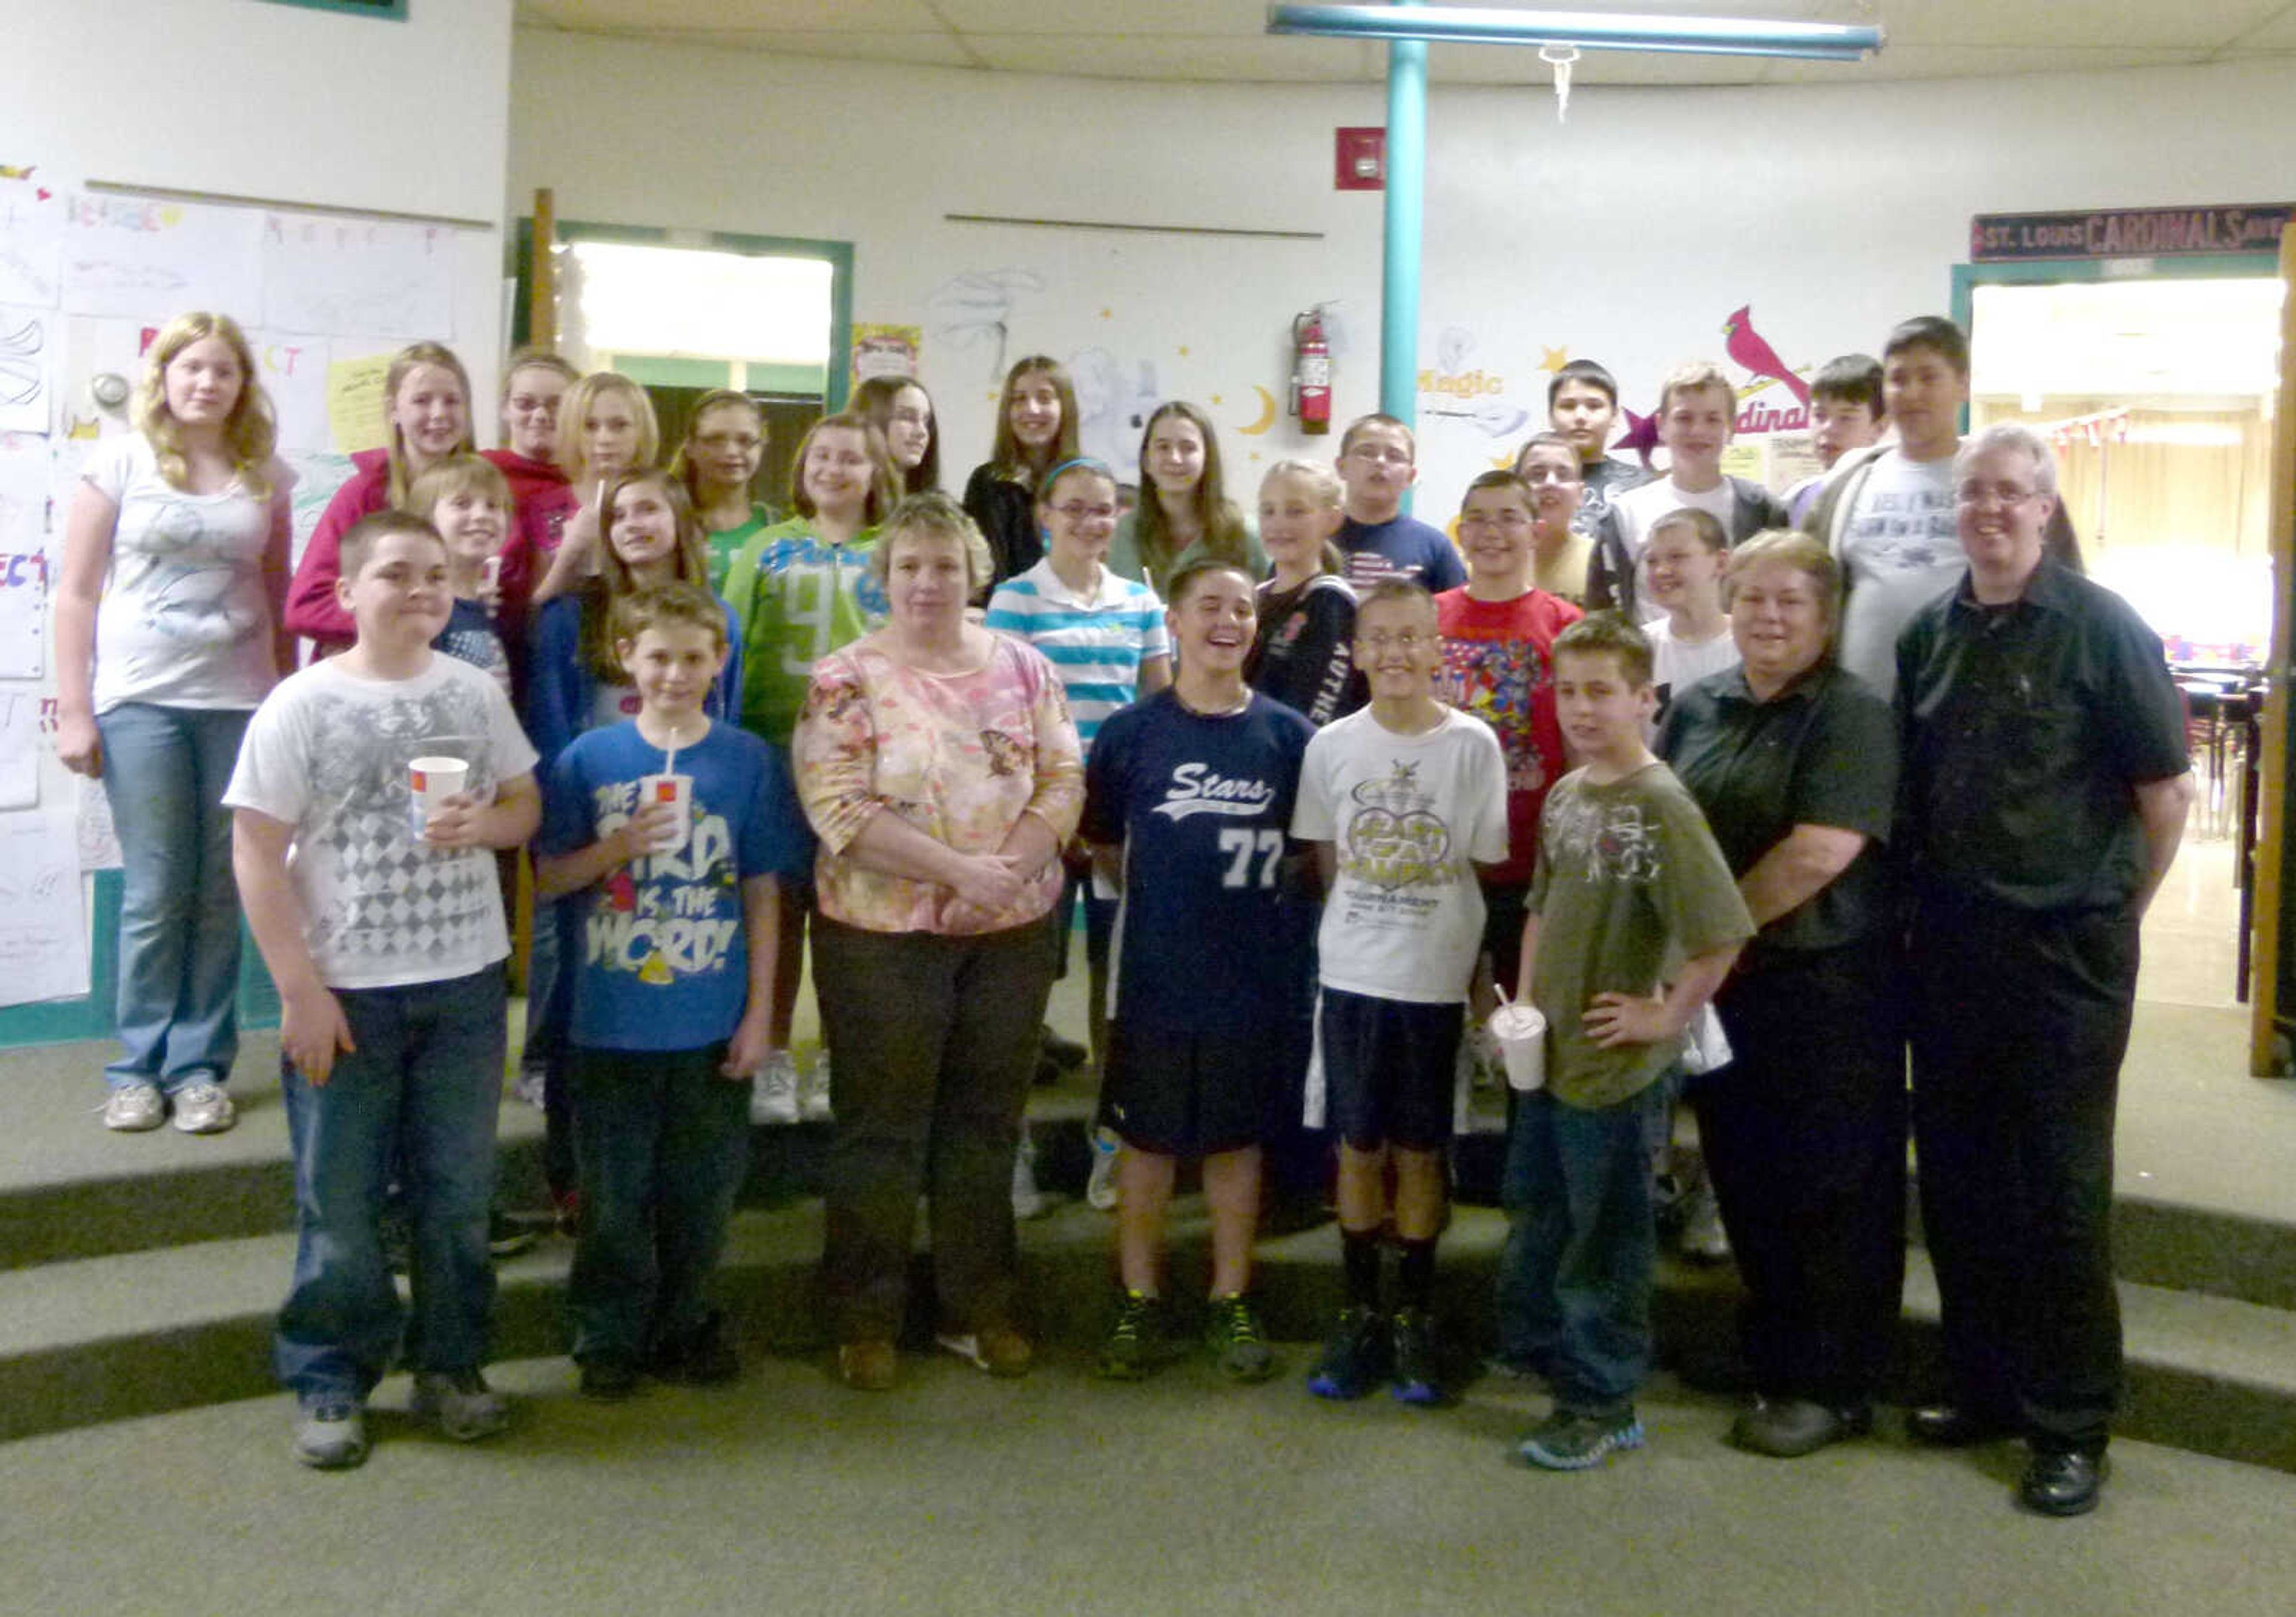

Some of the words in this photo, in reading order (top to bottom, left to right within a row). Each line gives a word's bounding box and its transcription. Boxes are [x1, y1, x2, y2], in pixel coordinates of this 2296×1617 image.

[1985, 226, 2017, 249] ST.
[2021, 224, 2082, 249] LOUIS
[2086, 210, 2243, 253] CARDINALS
[1418, 369, 1504, 399] Magic
[1733, 401, 1810, 435] dinal
[1166, 762, 1266, 801] Stars
[1218, 828, 1285, 888] 77
[671, 885, 719, 918] THE
[584, 915, 740, 973] WORD!
